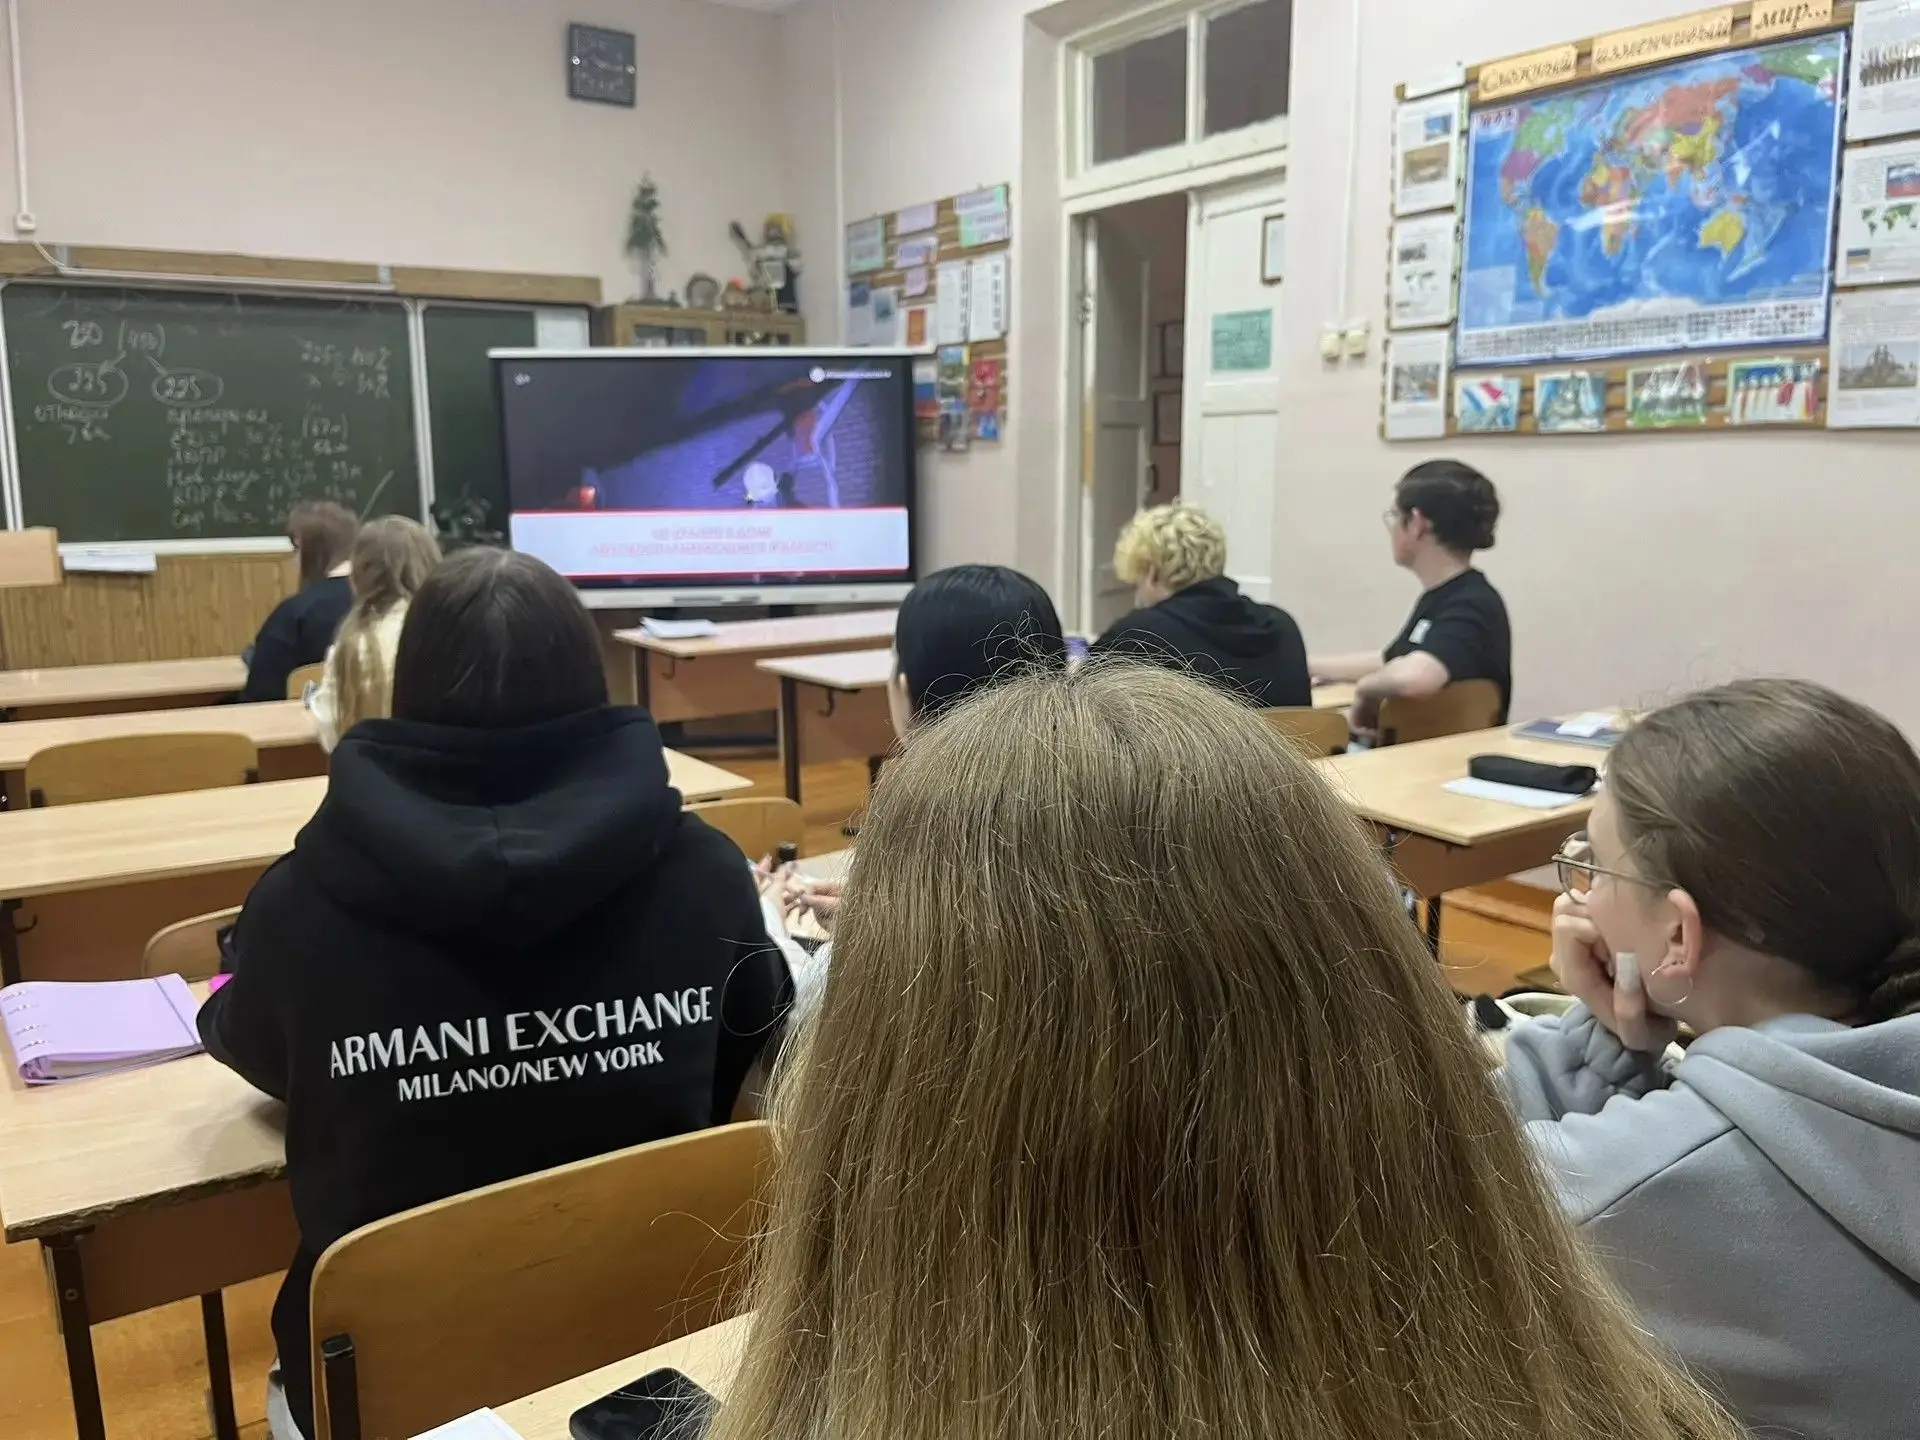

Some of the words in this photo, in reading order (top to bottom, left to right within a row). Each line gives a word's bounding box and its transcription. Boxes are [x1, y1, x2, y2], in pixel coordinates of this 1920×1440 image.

[1756, 3, 1829, 31] мир...
[330, 1017, 491, 1079] ARMANI
[505, 985, 713, 1051] EXCHANGE
[398, 1053, 588, 1101] MILANO/NEW
[594, 1040, 664, 1073] YORK
